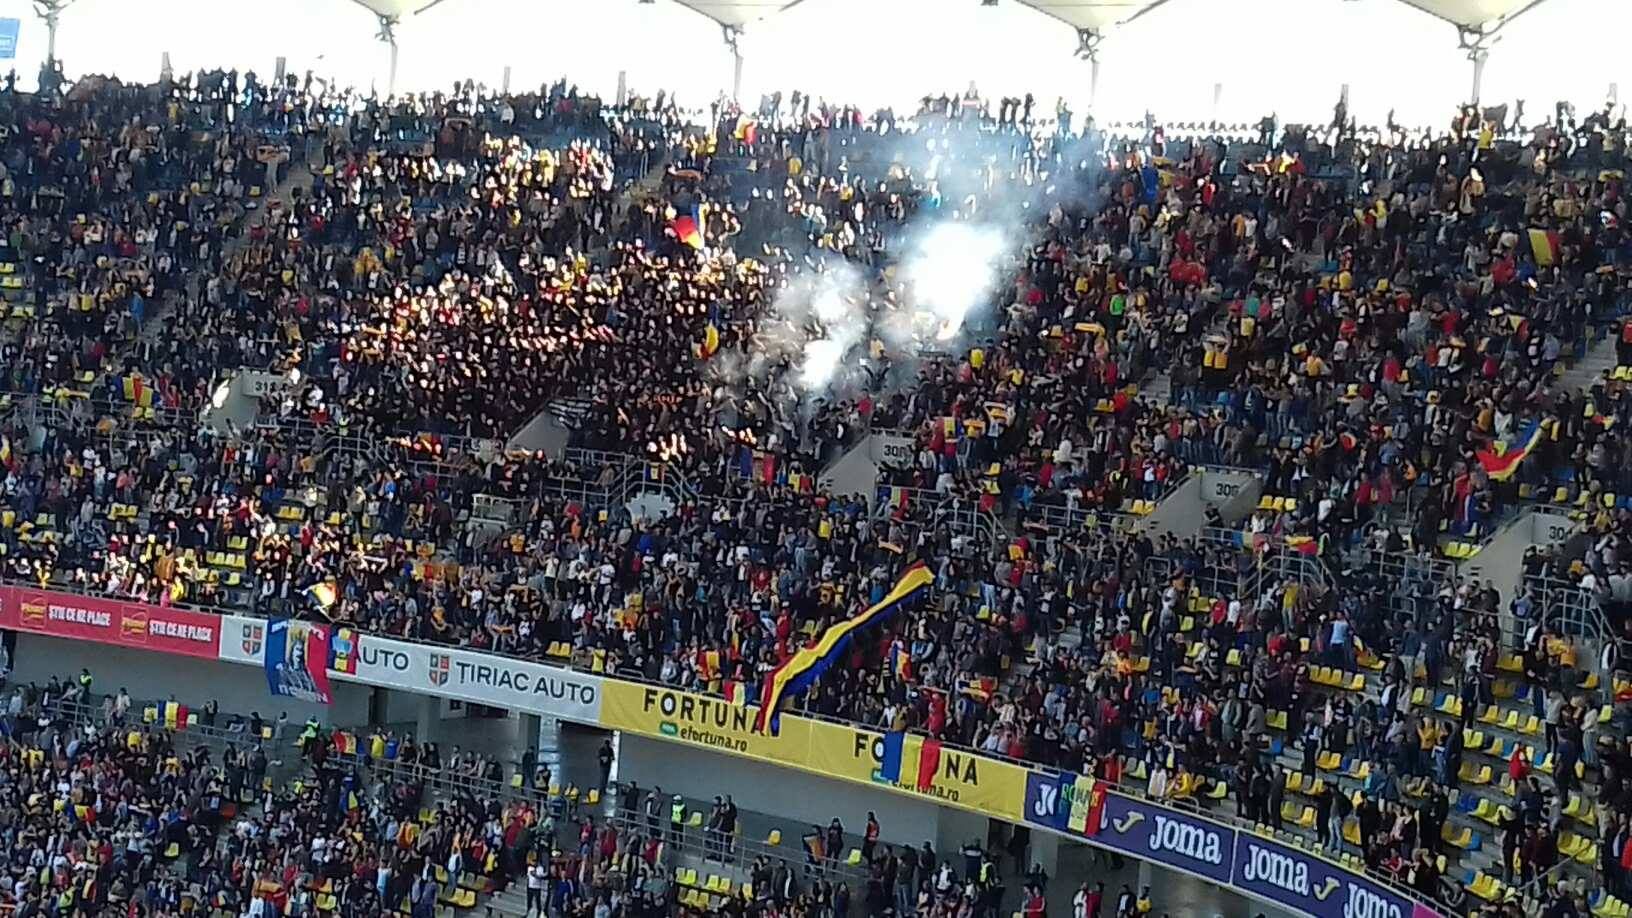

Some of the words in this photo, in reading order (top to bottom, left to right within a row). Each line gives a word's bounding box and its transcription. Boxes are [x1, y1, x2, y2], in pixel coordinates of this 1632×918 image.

[357, 646, 409, 671] UTO
[533, 677, 595, 704] AUTO
[680, 725, 747, 752] efortuna.ro
